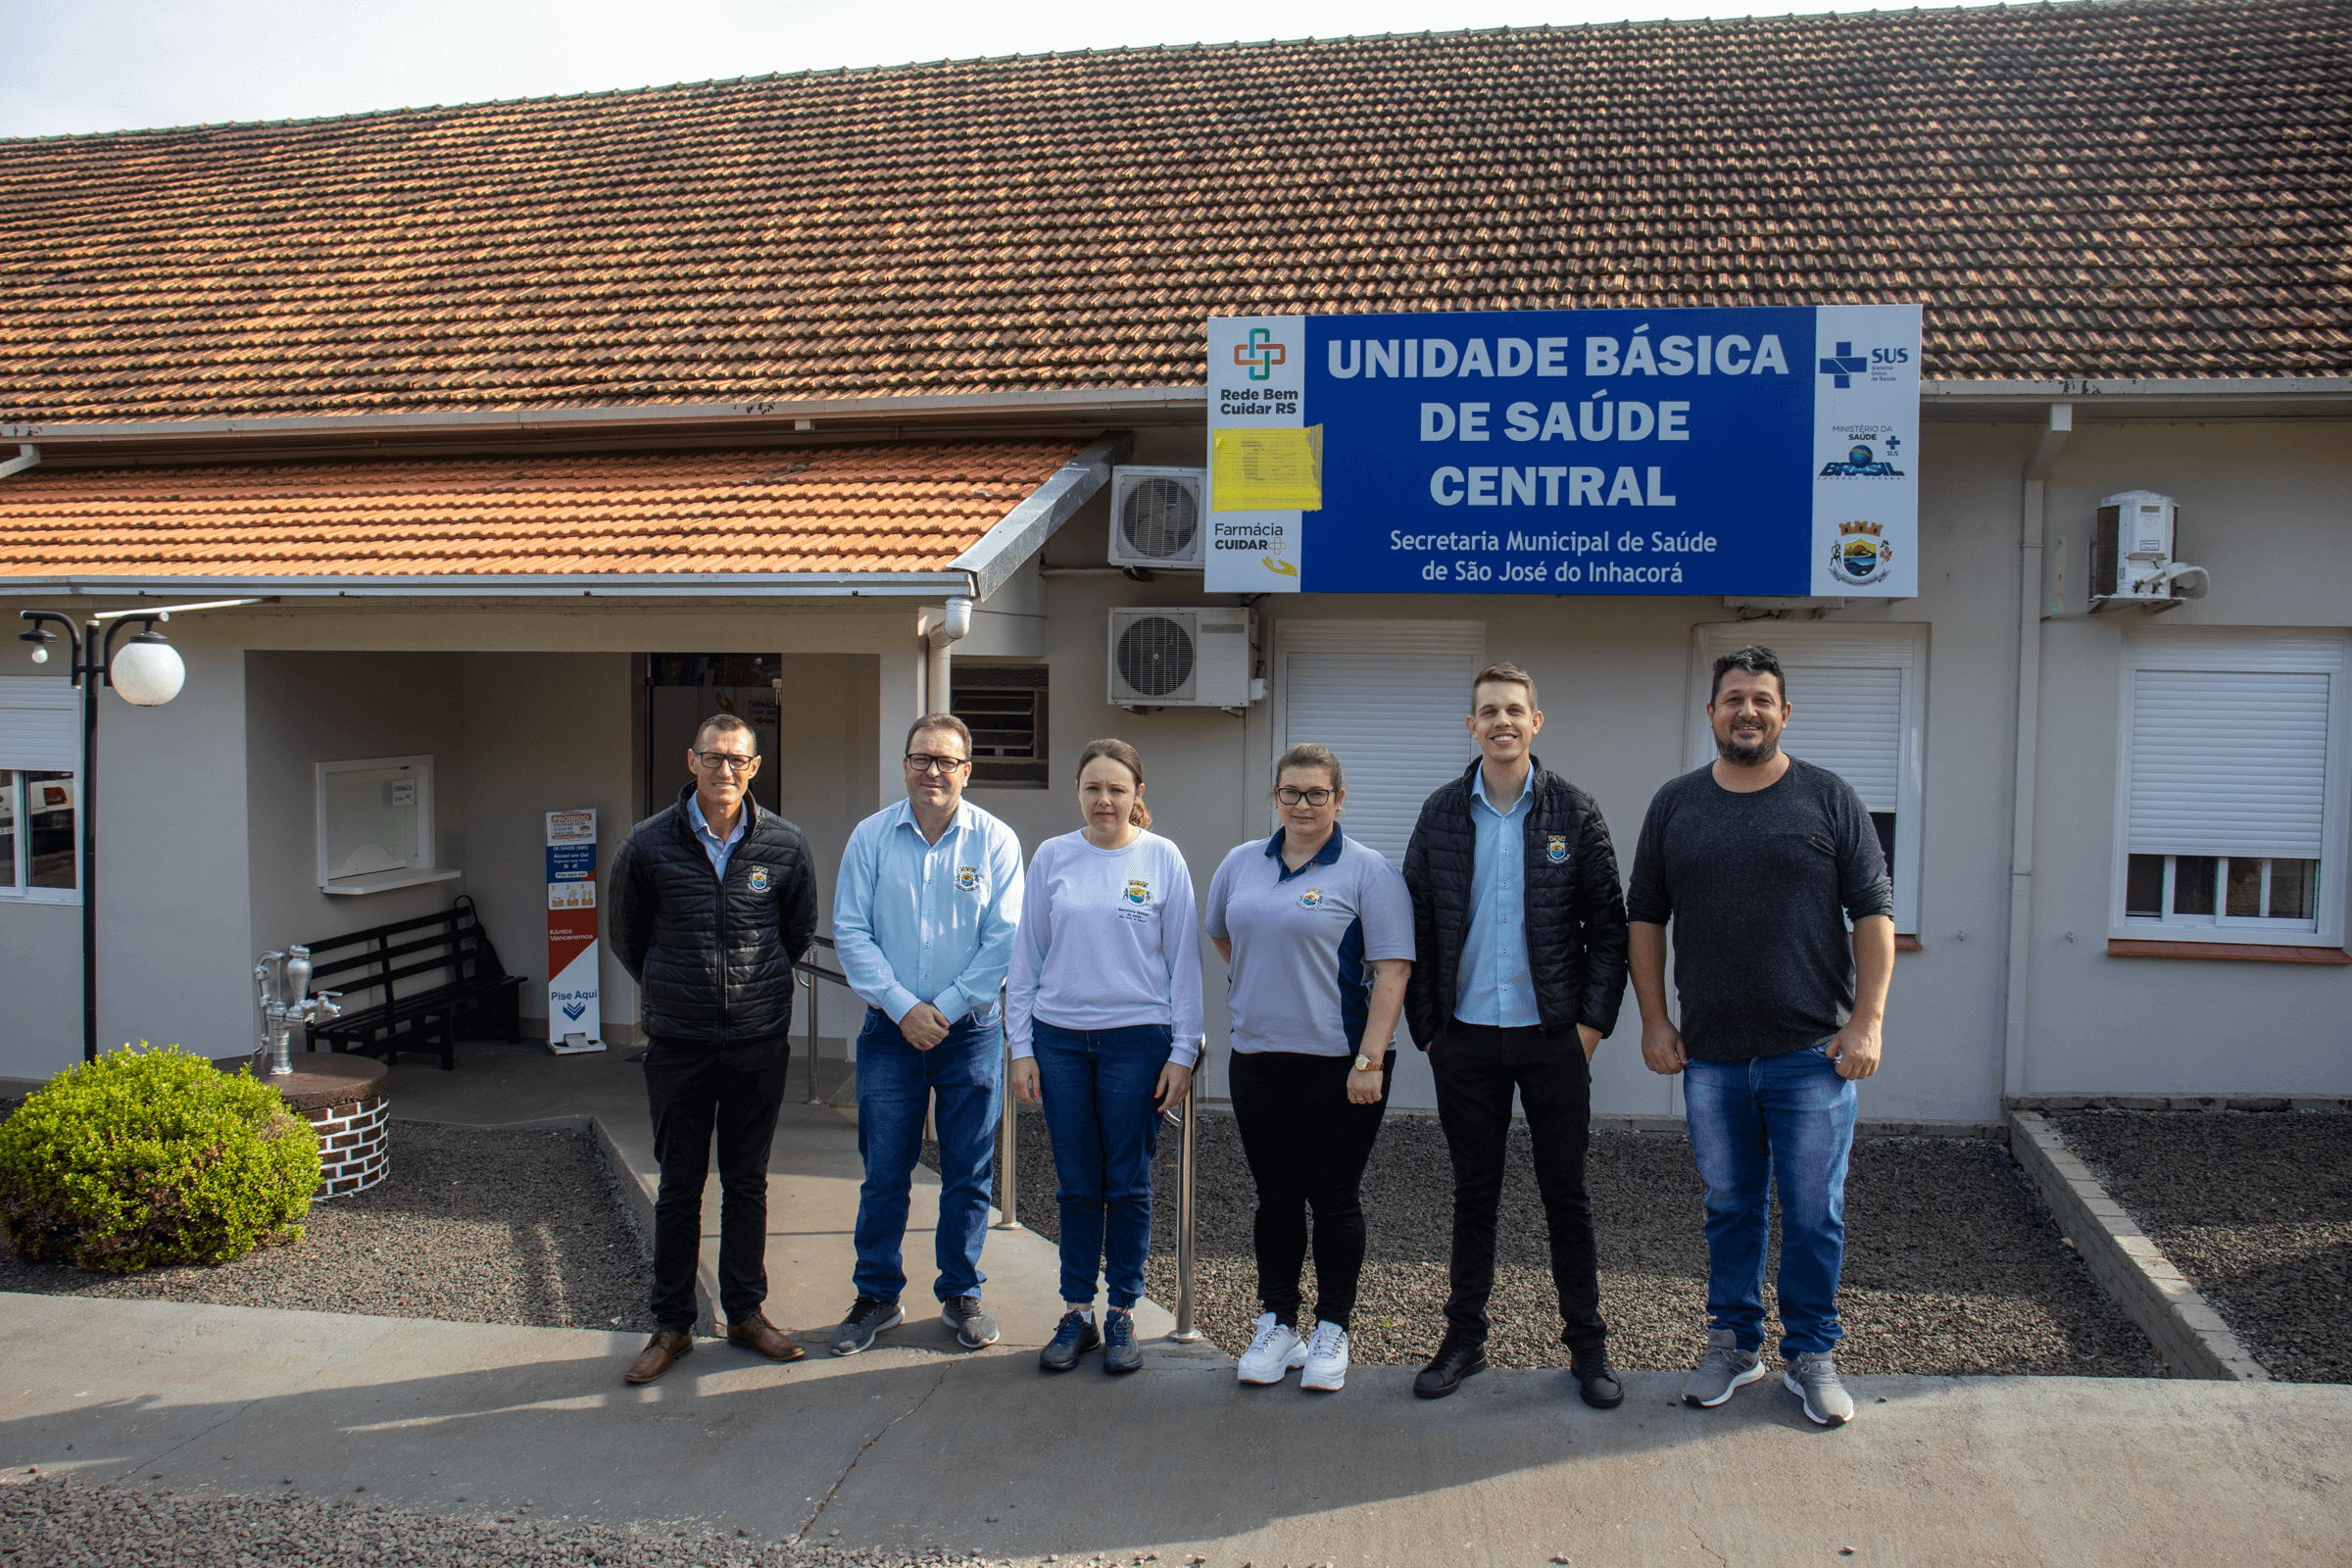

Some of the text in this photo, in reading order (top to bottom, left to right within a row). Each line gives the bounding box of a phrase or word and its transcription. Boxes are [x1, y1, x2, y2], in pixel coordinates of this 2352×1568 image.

[1328, 322, 1789, 379] UNIDADE BÁSICA
[1871, 347, 1909, 364] SUS
[1220, 388, 1298, 401] Rede Bem
[1220, 402, 1298, 416] Cuidar RS
[1420, 388, 1690, 442] DE SAÚDE
[1832, 423, 1880, 433] MINISTÉRIO
[1848, 431, 1878, 441] SAÚDE
[1818, 462, 1906, 477] BRASIL
[1430, 466, 1677, 507] CENTRAL
[1214, 522, 1284, 536] Farmácia
[1214, 539, 1268, 551] CUIDAR
[1390, 529, 1718, 557] Secretaria Municipal de Saúde
[1421, 560, 1683, 583] de São José do Inhacorá
[551, 989, 598, 1001] Pise Aqui
